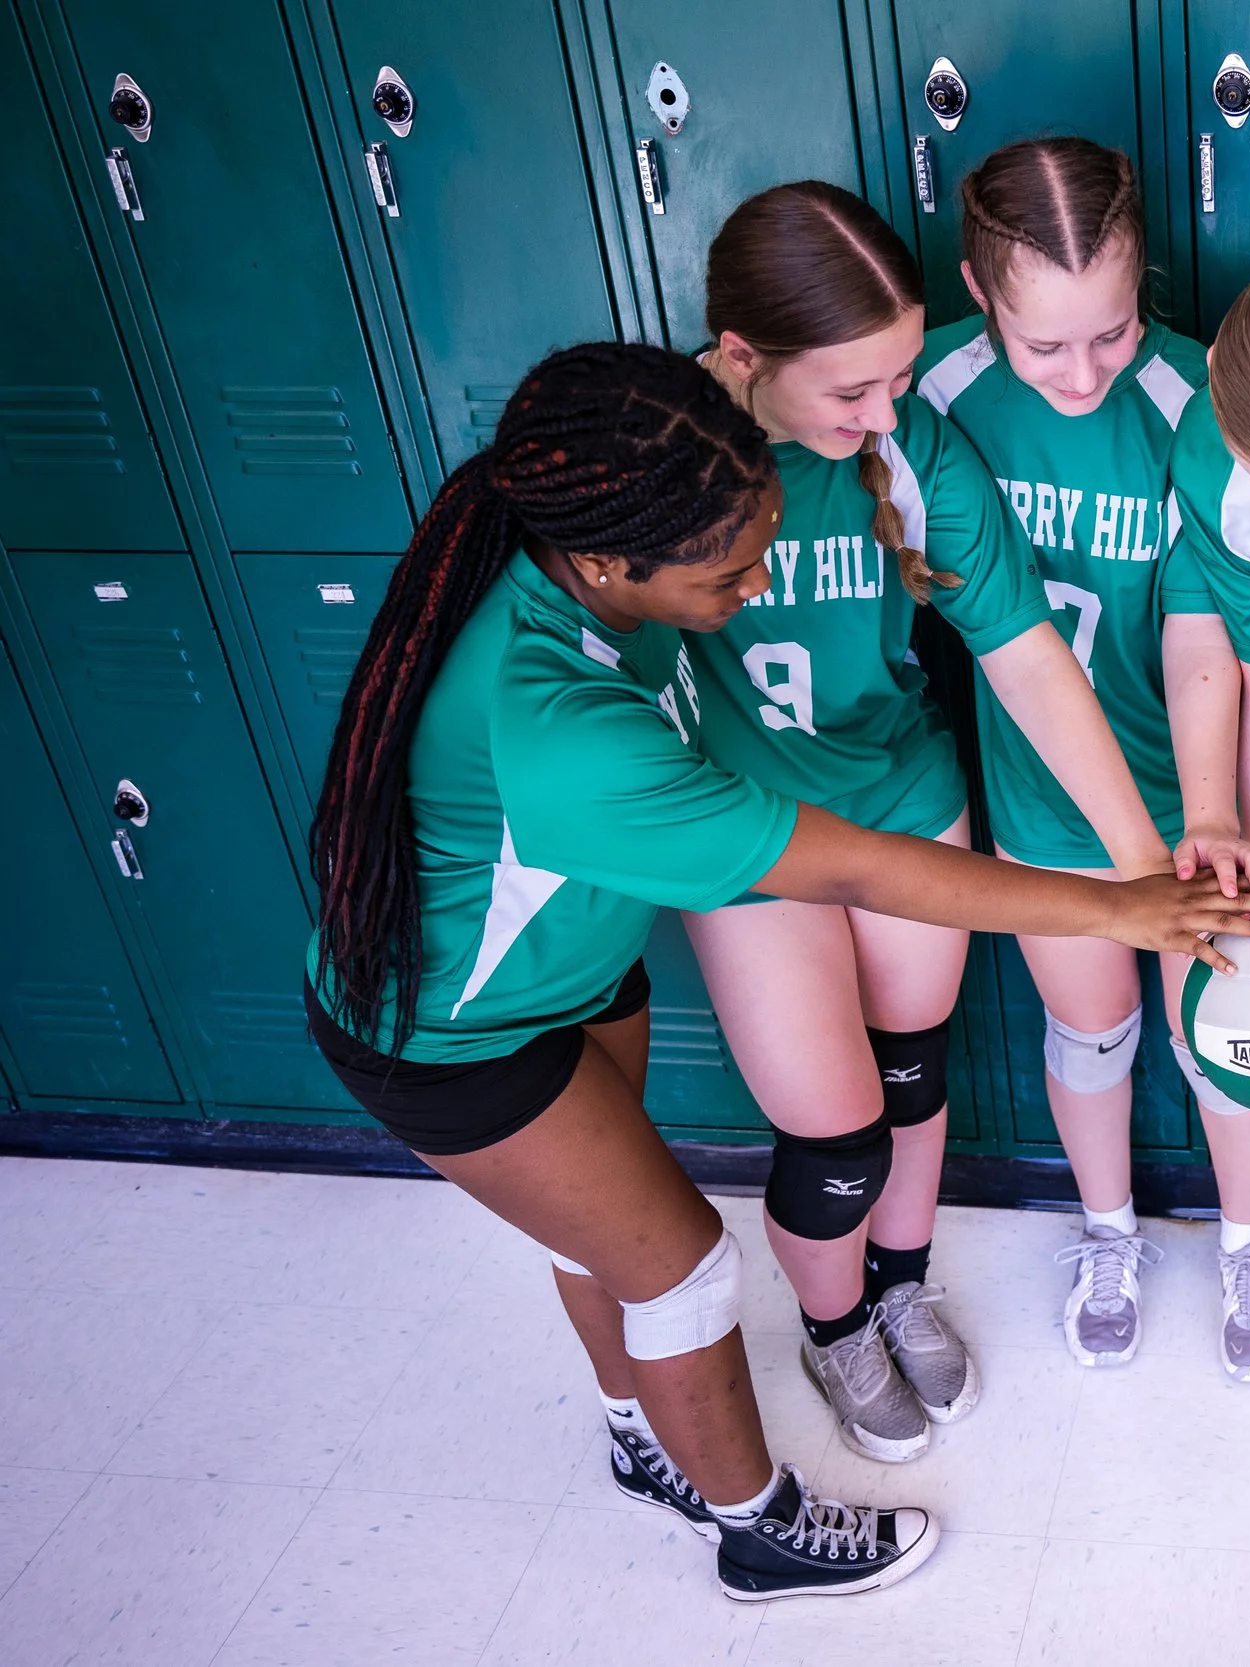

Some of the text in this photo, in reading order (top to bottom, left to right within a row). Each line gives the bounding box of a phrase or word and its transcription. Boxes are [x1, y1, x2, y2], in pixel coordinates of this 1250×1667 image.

[639, 157, 653, 197] PENCO
[1044, 579, 1102, 690] 7
[743, 641, 817, 737] 9
